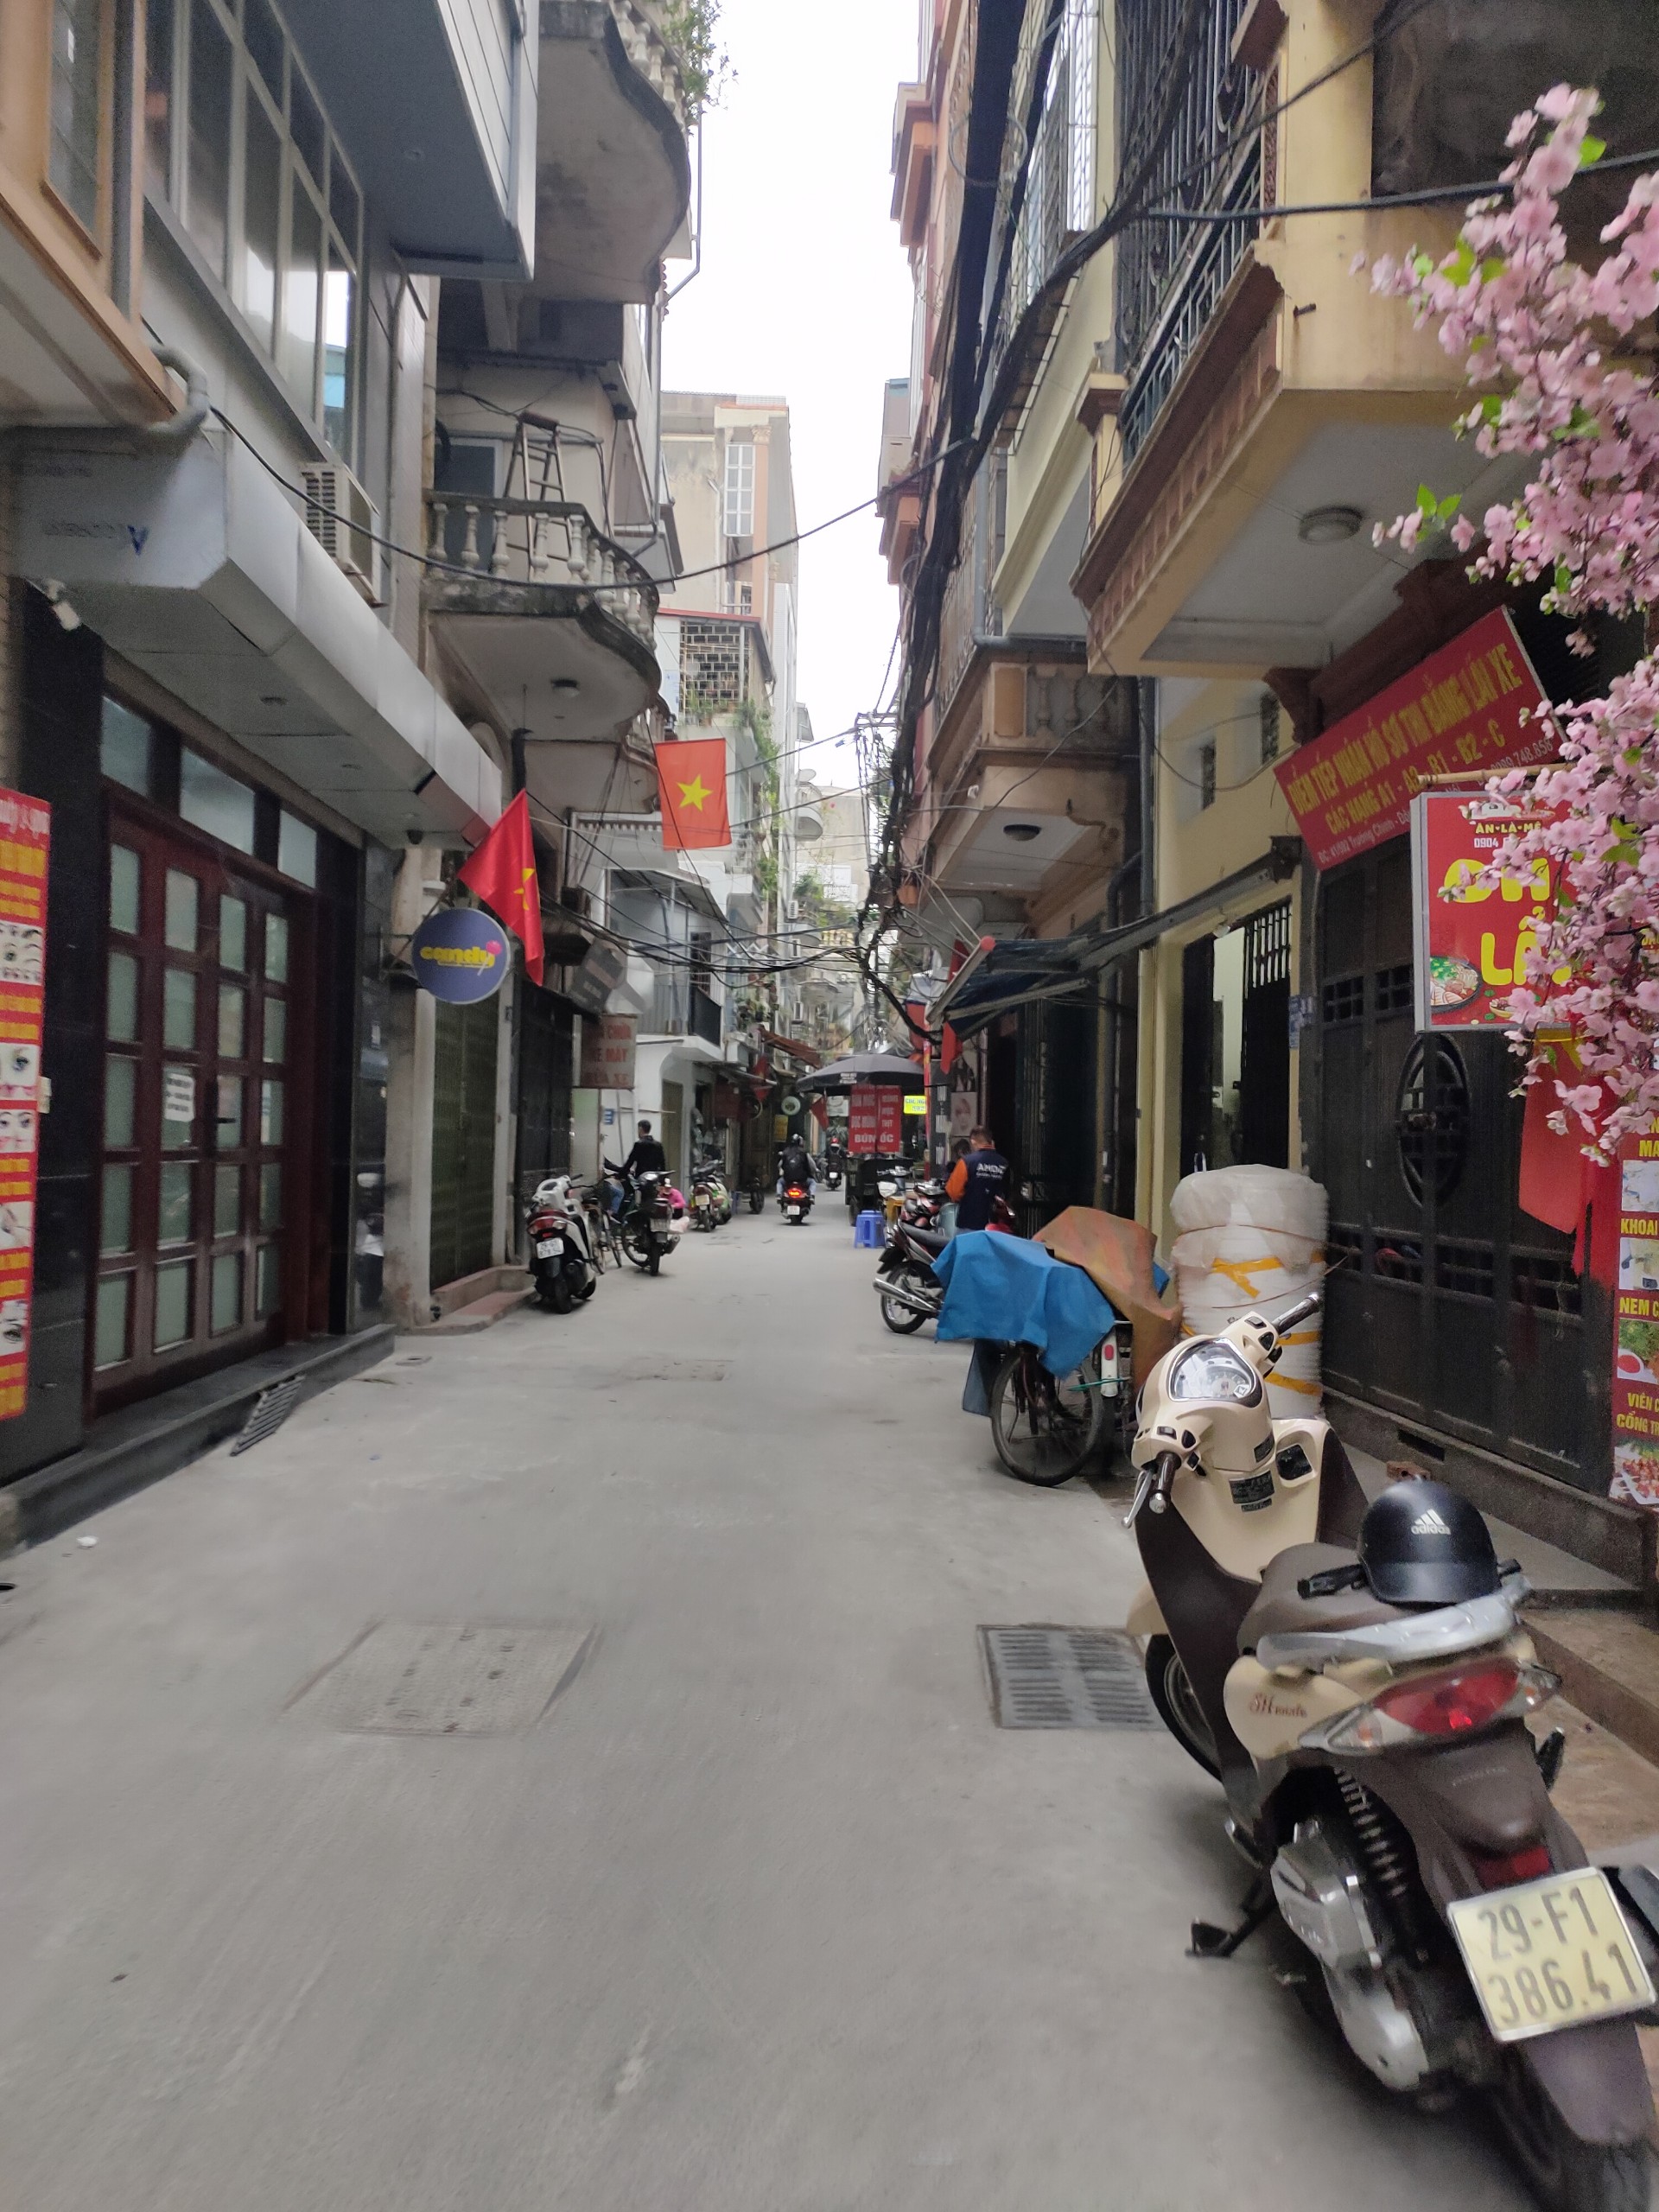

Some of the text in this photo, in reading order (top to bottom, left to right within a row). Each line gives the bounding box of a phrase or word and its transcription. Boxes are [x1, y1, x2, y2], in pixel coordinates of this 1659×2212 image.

[1486, 643, 1522, 695] XE
[1456, 733, 1483, 765] B2
[1487, 719, 1505, 747] C
[1473, 837, 1499, 849] 0904
[854, 1130, 894, 1143] BÚN ỐC
[1620, 1218, 1658, 1236] KHOAI
[1619, 1297, 1649, 1316] NEM
[1627, 1392, 1653, 1410] VIÊN
[1411, 1525, 1452, 1535] adidas
[1477, 1885, 1599, 1962] 29-F1
[1487, 1944, 1637, 2025] 386.41
